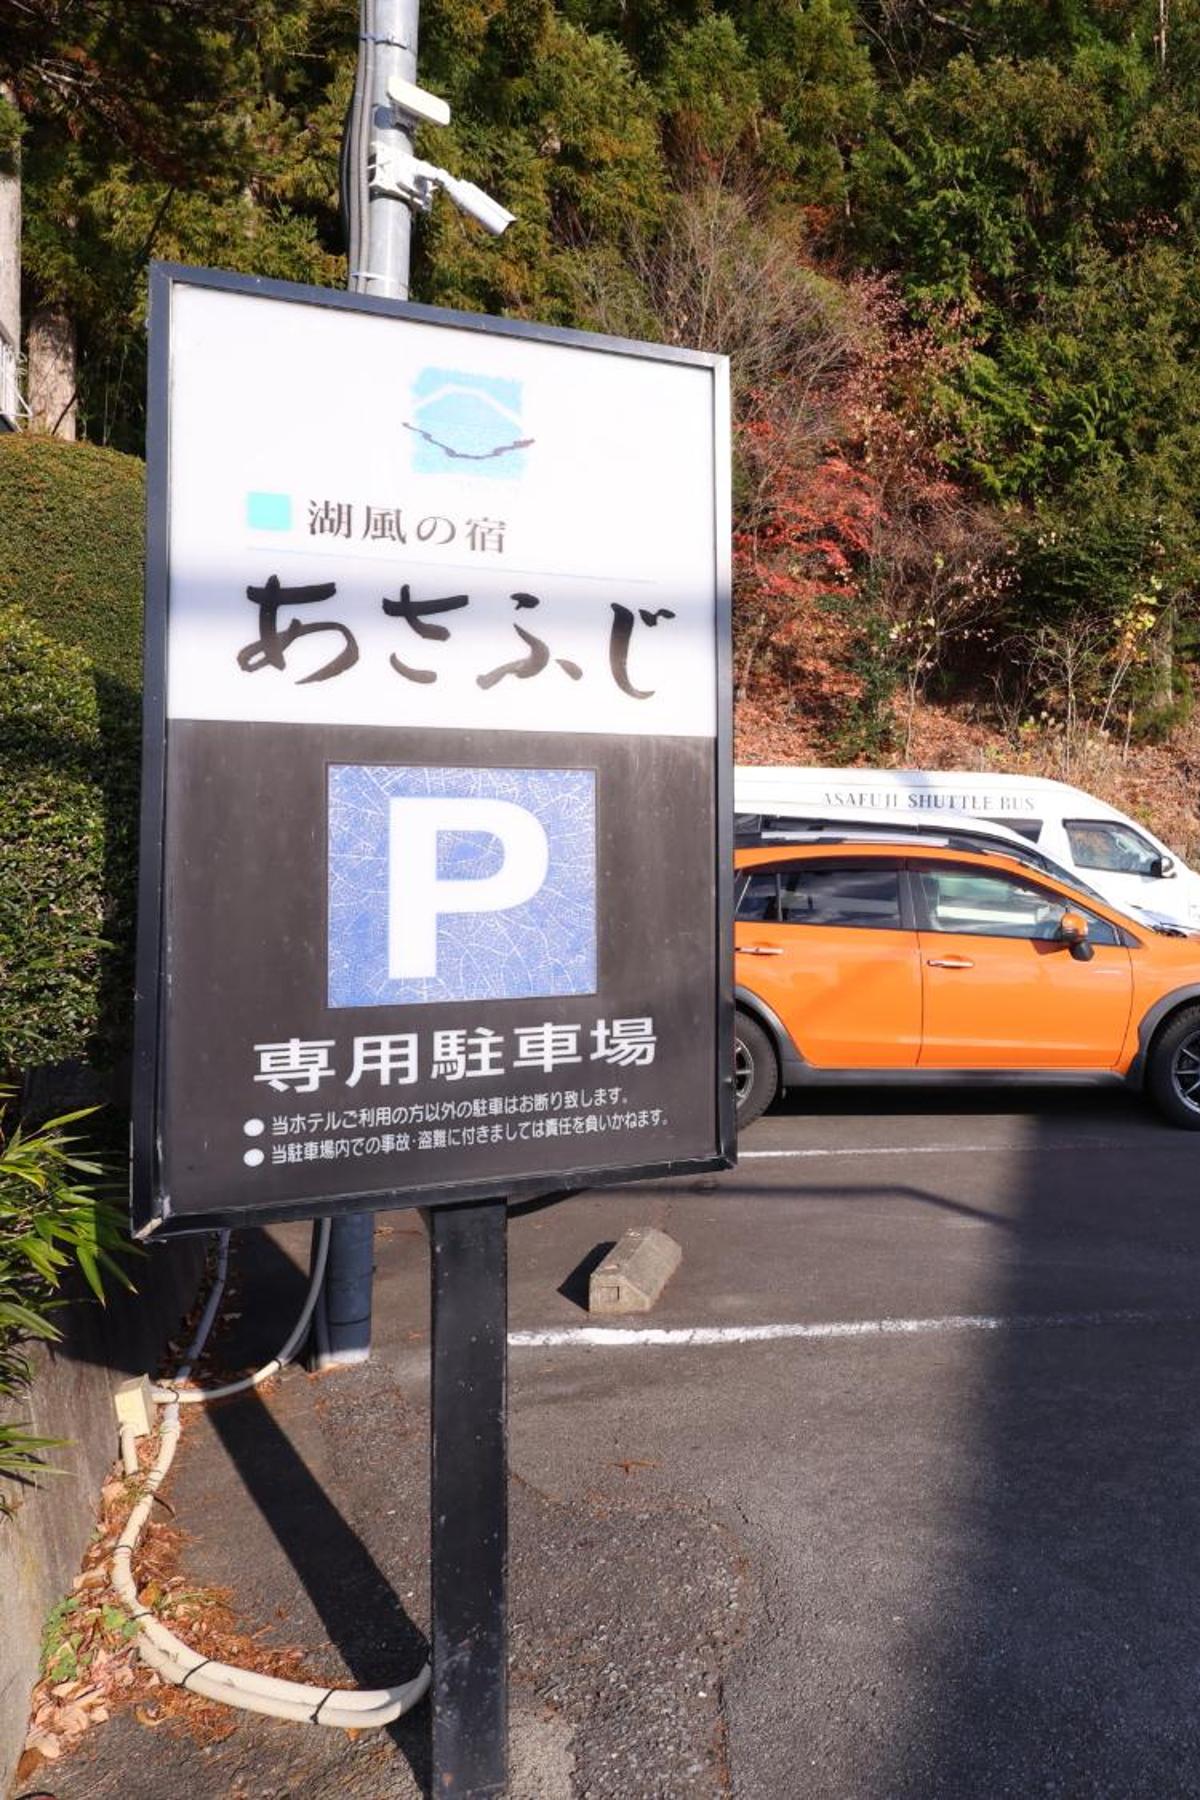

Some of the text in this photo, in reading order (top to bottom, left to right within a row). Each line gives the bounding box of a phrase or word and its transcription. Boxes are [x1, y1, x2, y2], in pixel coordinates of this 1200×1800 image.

[307, 499, 506, 553] 湖風の宿
[237, 574, 676, 700] あさふじ
[824, 792, 1036, 811] ASAFUJI SHUTTLE BUS
[388, 796, 550, 980] P
[253, 1016, 658, 1094] 専用駐車場
